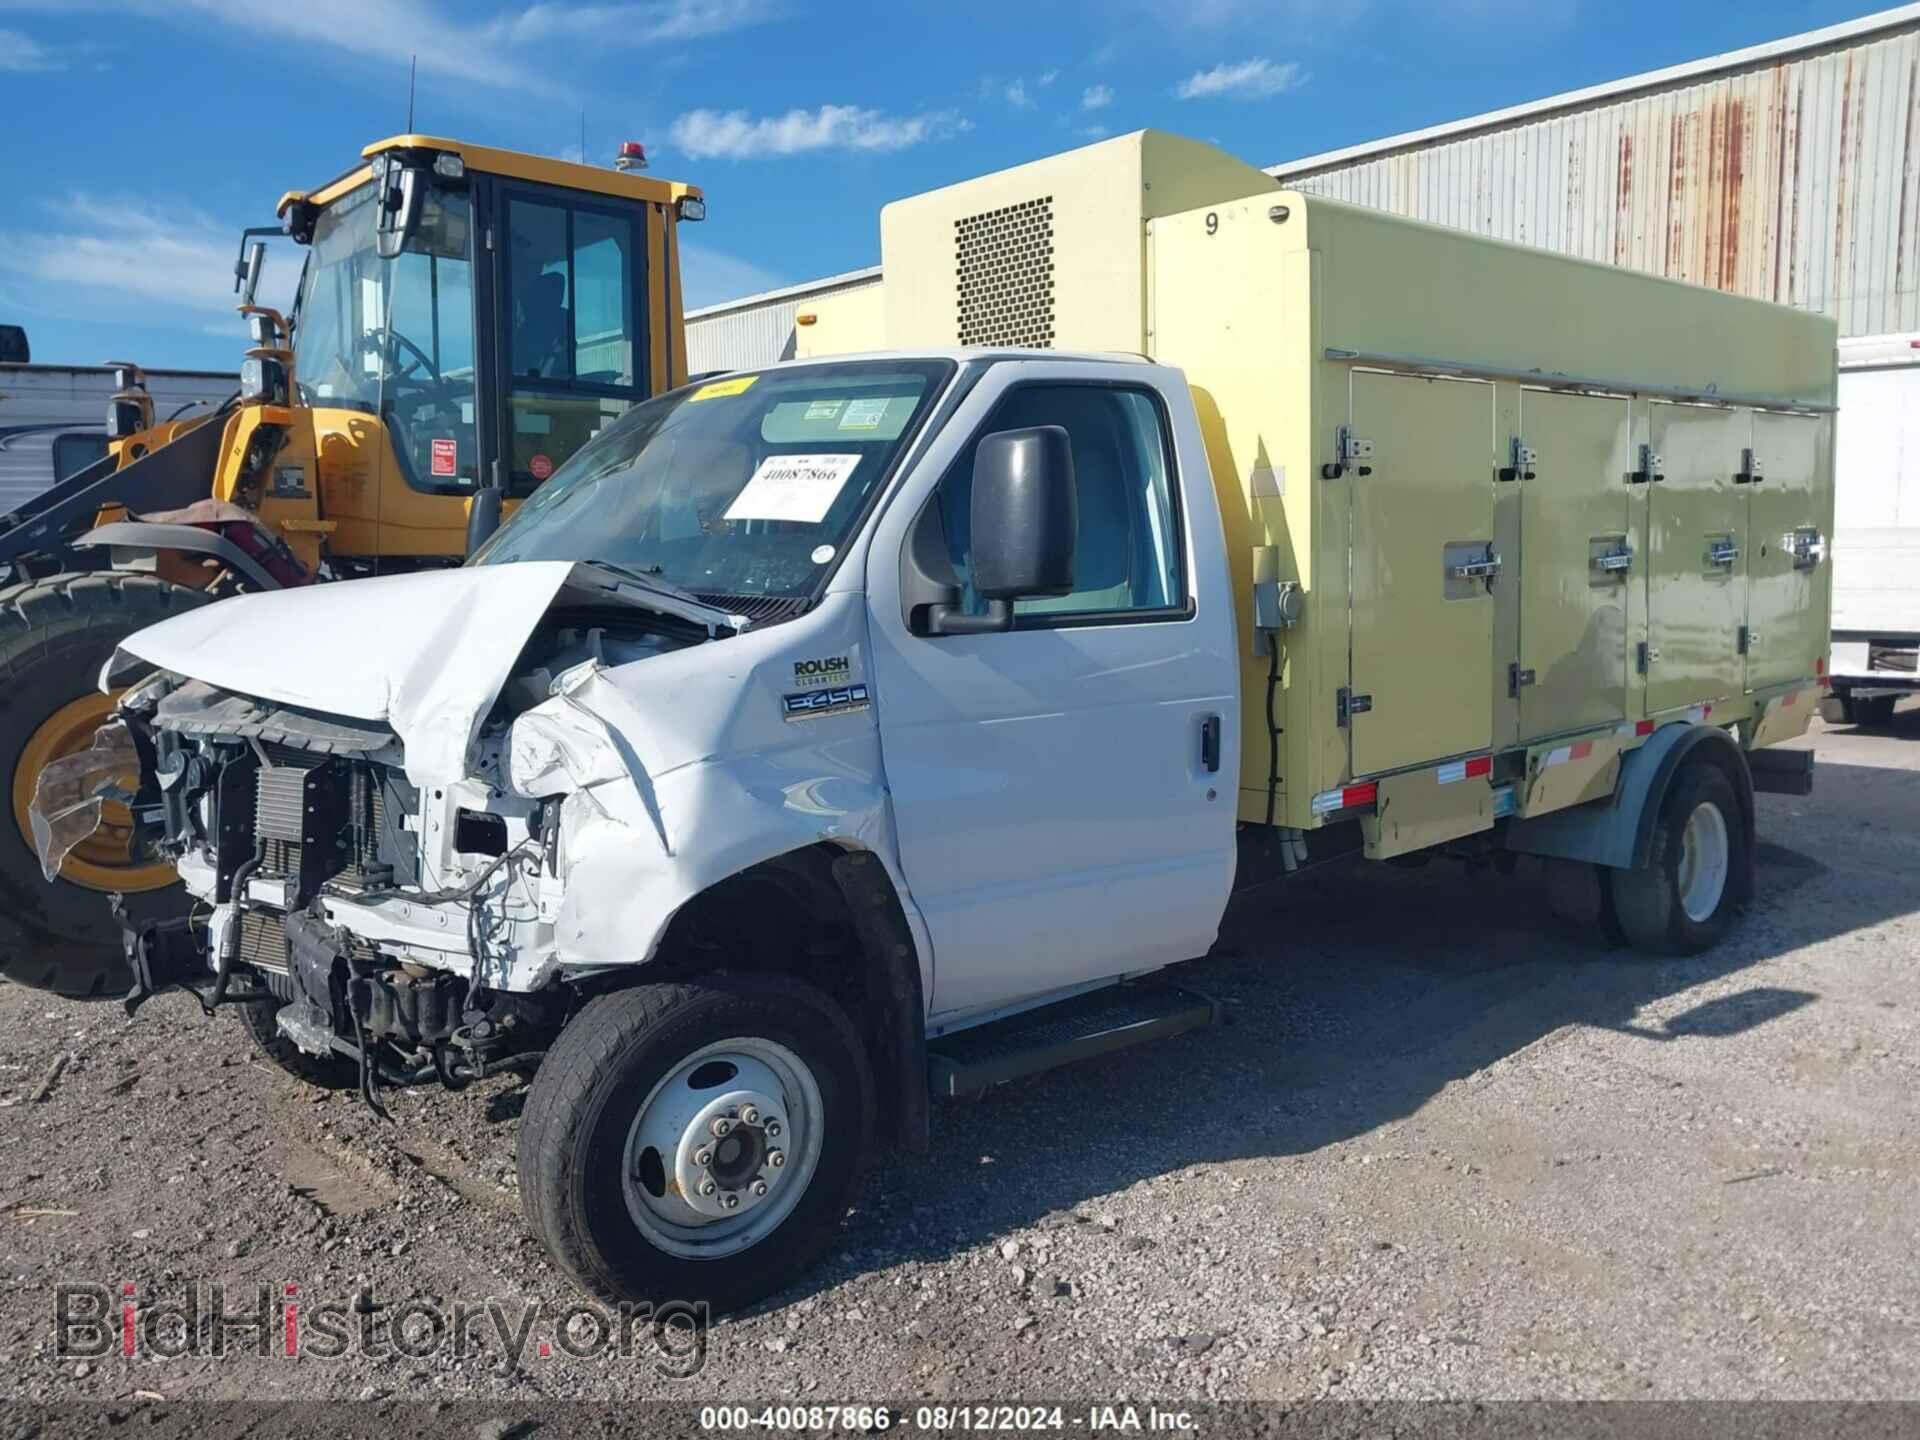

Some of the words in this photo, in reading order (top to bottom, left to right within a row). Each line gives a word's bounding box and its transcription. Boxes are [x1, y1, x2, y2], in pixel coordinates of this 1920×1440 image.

[1206, 212, 1219, 236] 9
[762, 467, 838, 481] 40087866
[794, 657, 848, 675] ROUSH
